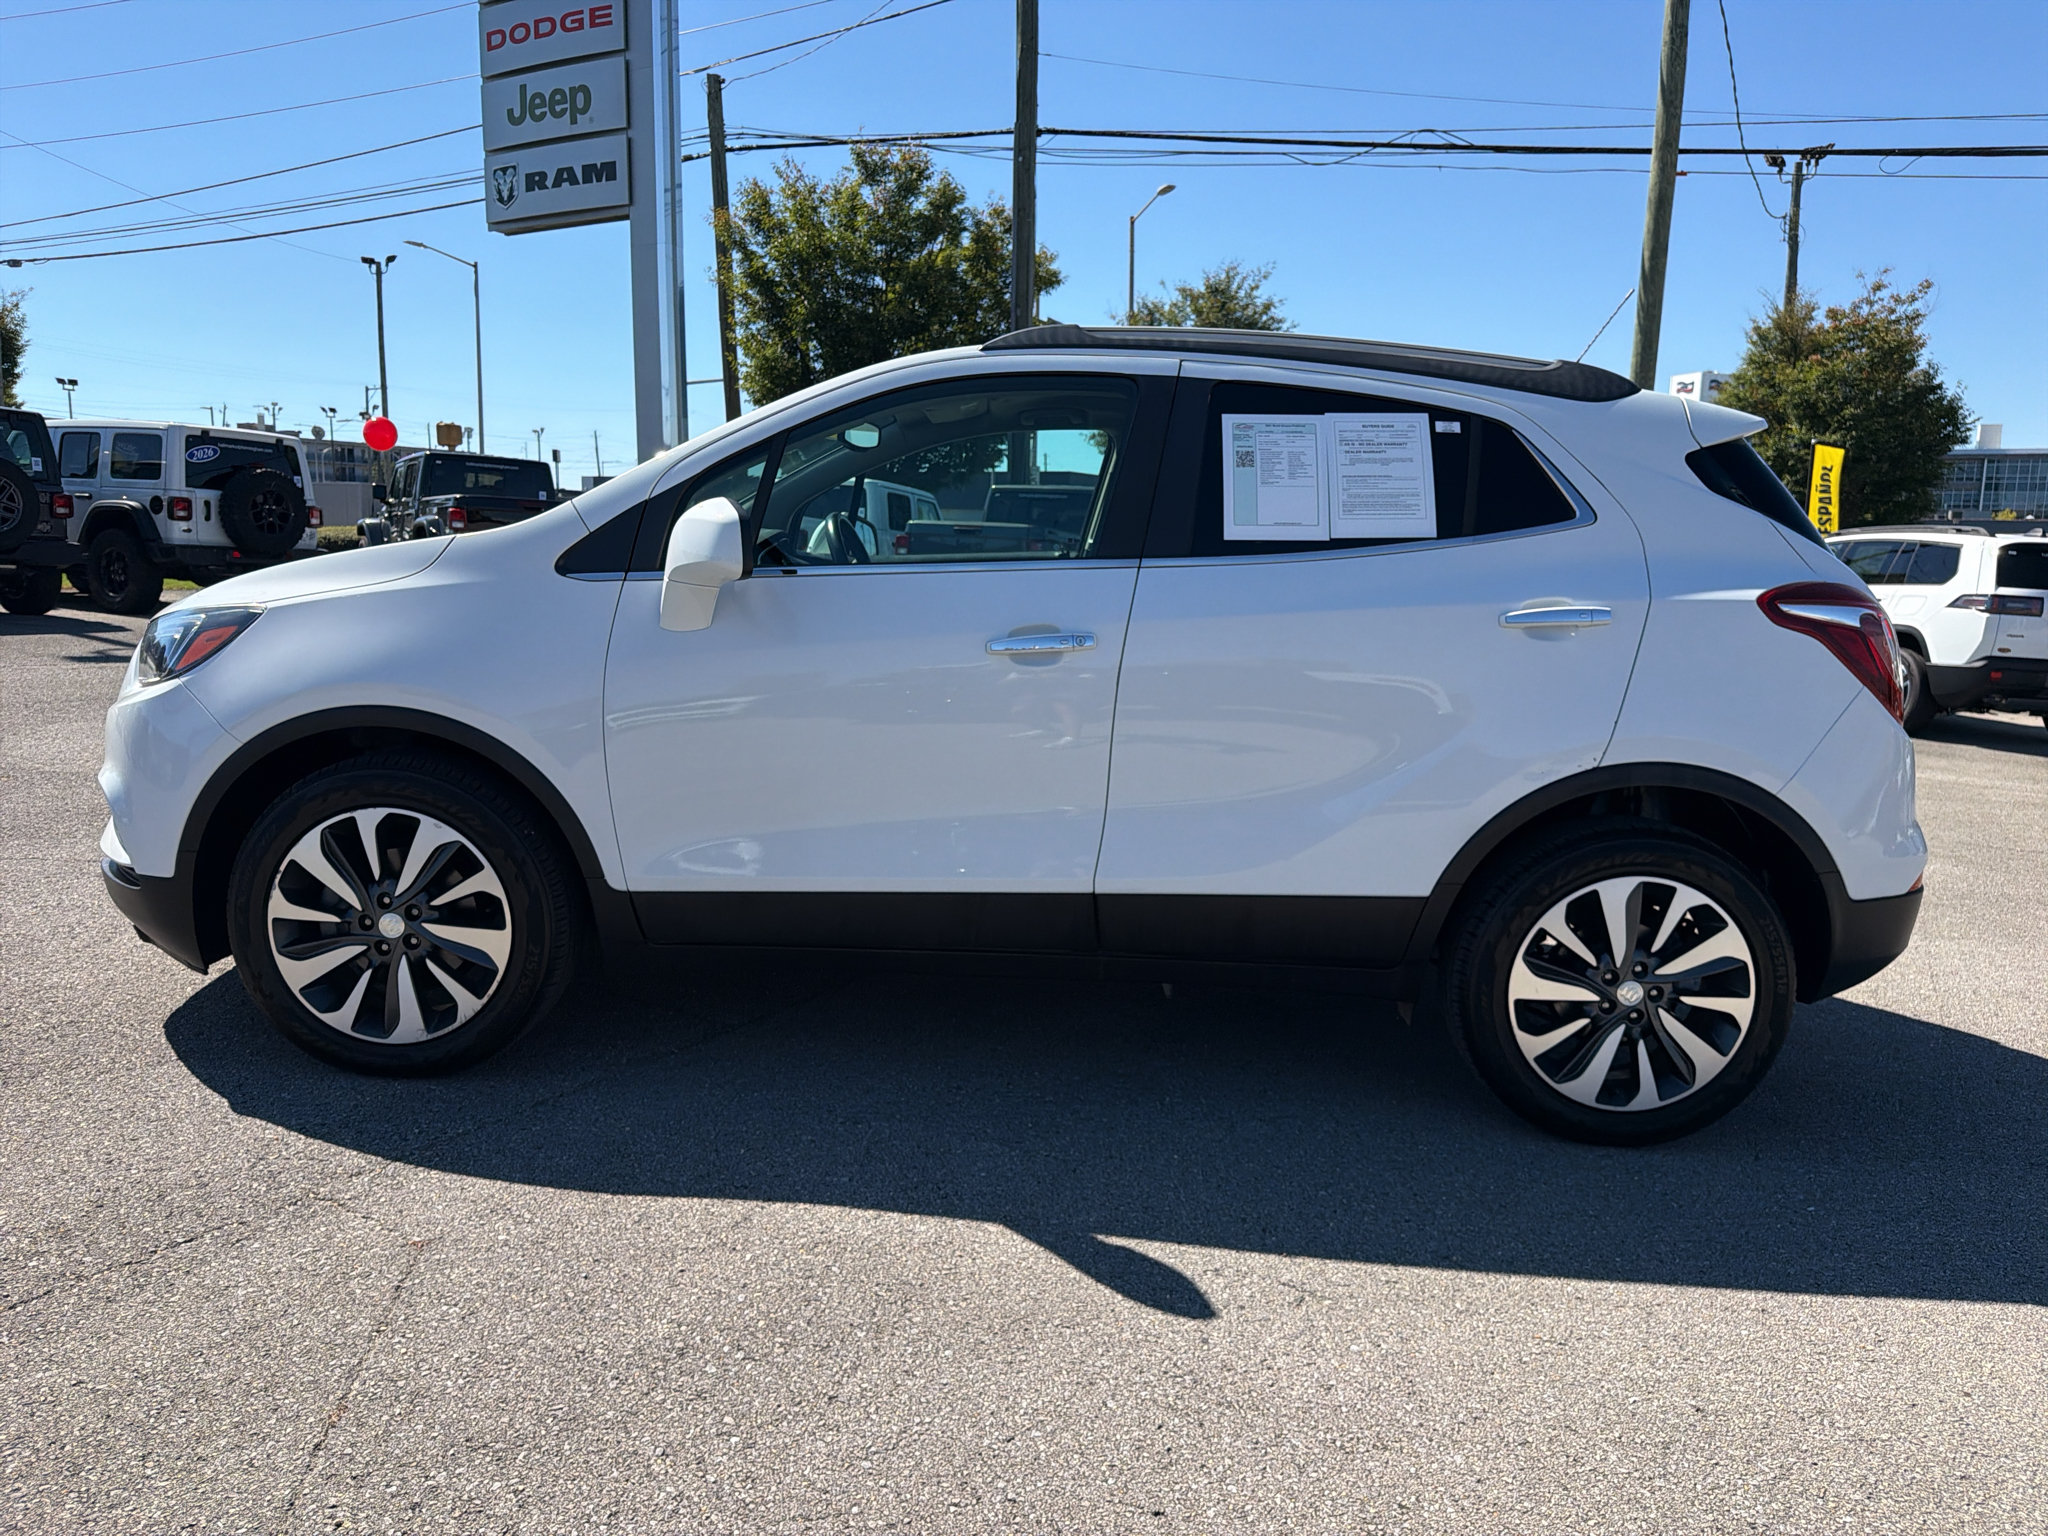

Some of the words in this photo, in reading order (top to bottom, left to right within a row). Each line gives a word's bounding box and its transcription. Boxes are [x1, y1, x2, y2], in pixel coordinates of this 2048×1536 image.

[486, 4, 613, 52] DODGE
[506, 83, 592, 127] Jeep
[525, 160, 617, 193] RAM
[192, 447, 215, 460] 2026
[1815, 465, 1834, 535] ESPAÑOL
